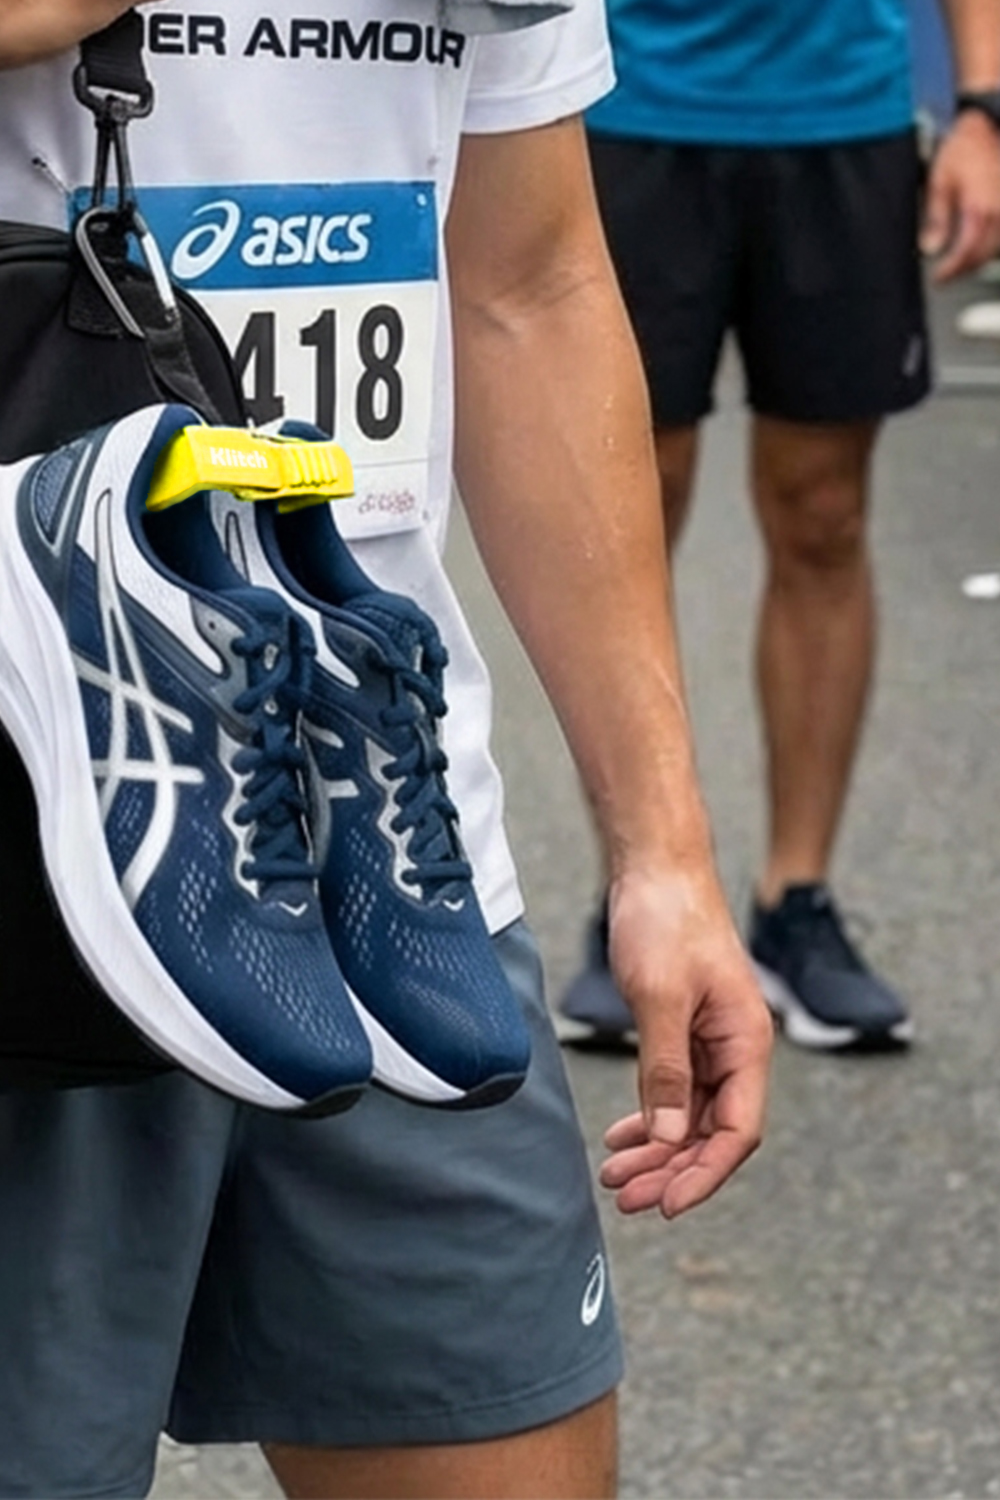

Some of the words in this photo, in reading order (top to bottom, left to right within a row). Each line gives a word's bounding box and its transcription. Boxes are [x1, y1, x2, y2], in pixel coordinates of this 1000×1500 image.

[242, 17, 467, 69] ARMOUR
[241, 214, 373, 267] asics
[231, 304, 405, 442] 418
[209, 446, 268, 469] Klitch
